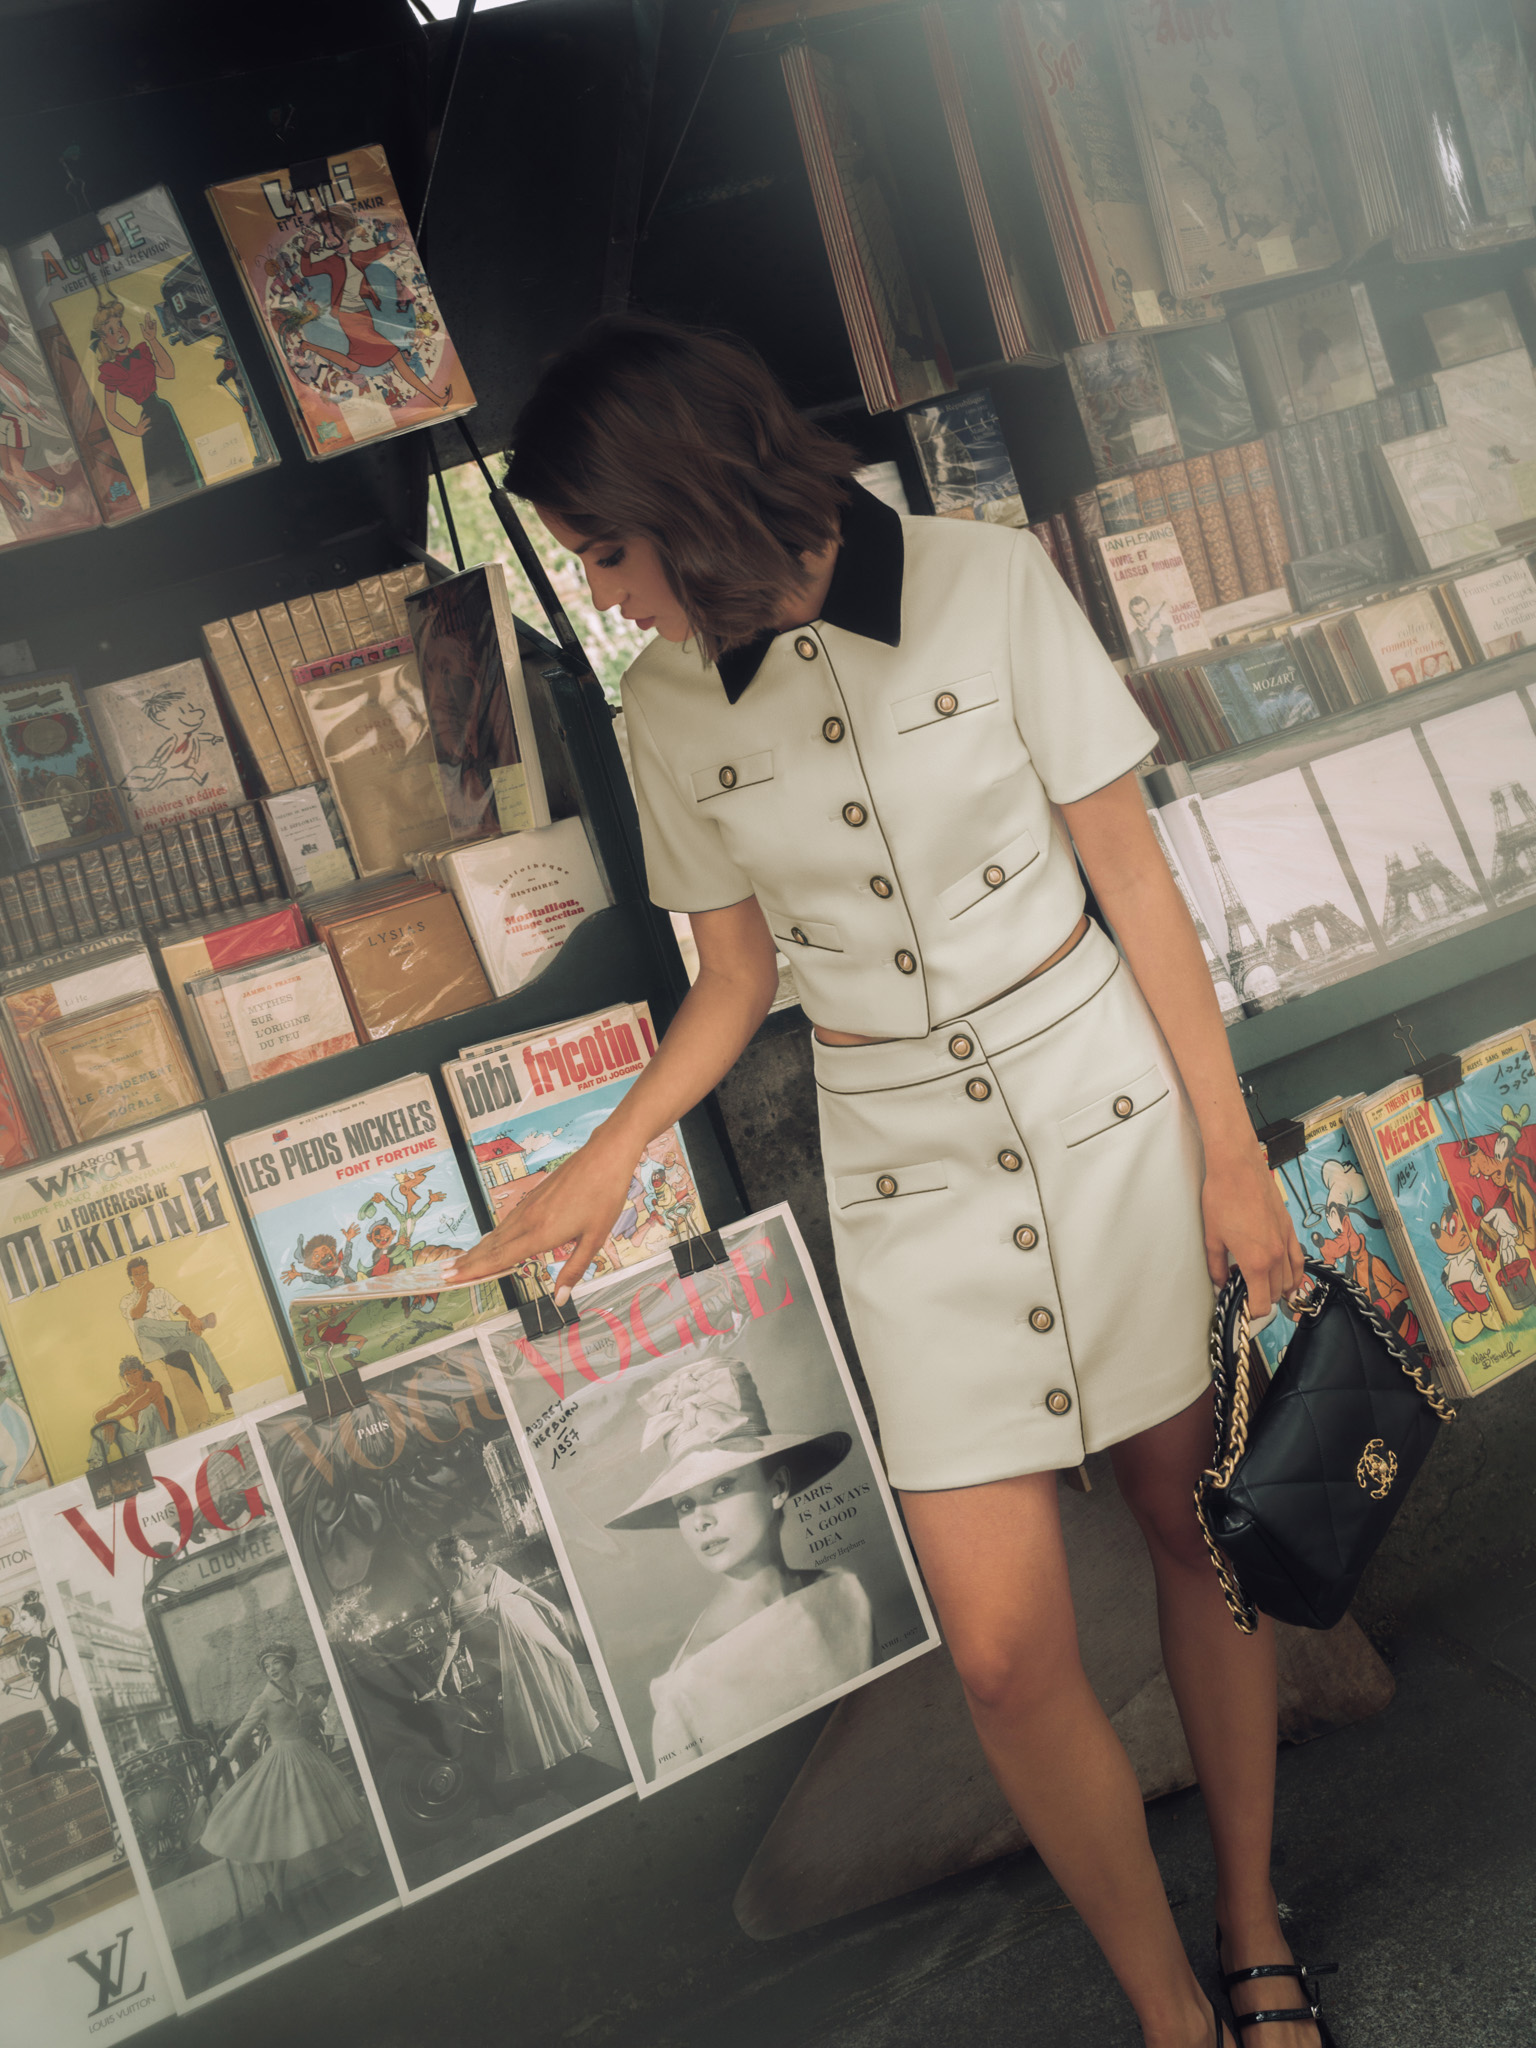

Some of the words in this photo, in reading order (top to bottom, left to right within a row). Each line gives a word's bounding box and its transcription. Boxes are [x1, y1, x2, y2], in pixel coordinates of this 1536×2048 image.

[351, 195, 386, 213] FAKIR
[1104, 540, 1124, 552] IAN
[1125, 527, 1174, 547] FLEMING
[1108, 553, 1134, 568] VIVRE
[1137, 549, 1148, 561] ET
[1113, 565, 1149, 582] LAISSER
[1151, 556, 1184, 573] MOURIR
[1170, 600, 1198, 614] JAMES
[1490, 595, 1506, 606] Les
[1172, 609, 1201, 625] BOND
[1381, 636, 1418, 655] romans
[1252, 671, 1295, 693] MOZART
[133, 801, 184, 821] Histoires
[185, 785, 228, 805] inédites
[188, 800, 229, 818] Nicolas
[510, 880, 560, 899] HISTOIRES
[504, 899, 580, 926] Montaillou,
[505, 919, 543, 936] village
[544, 906, 586, 924] occitan
[368, 921, 426, 947] LYSIAS
[243, 986, 266, 999] JAMES
[248, 993, 294, 1015] MYTHES
[251, 1013, 273, 1027] SUR
[255, 1014, 311, 1039] L'ORIGINE
[259, 1041, 276, 1051] DU
[279, 1031, 301, 1046] FEU
[455, 1053, 523, 1120] bibi
[522, 1018, 641, 1097] fricotin
[1485, 1053, 1500, 1064] SANS
[77, 1092, 95, 1106] LE
[98, 1063, 173, 1098] FONDEMENT
[577, 1081, 595, 1092] FAIT
[595, 1075, 608, 1086] DU
[608, 1062, 644, 1081] JOGGING
[108, 1092, 162, 1119] MORALE
[1384, 1090, 1410, 1114] THIERRY
[1411, 1086, 1423, 1098] LA
[1306, 1124, 1329, 1140] ENCONTRE
[1329, 1120, 1337, 1128] DU
[244, 1153, 281, 1194] LES
[280, 1132, 344, 1180] PIEDS
[342, 1099, 437, 1159] NICKELES
[336, 1160, 371, 1180] FONT
[375, 1137, 438, 1166] FORTUNE
[26, 1140, 152, 1203] WINCH
[69, 1151, 115, 1172] LARGO
[1396, 1161, 1418, 1198] 1964
[13, 1205, 51, 1224] PHILIPPE
[53, 1191, 92, 1211] FRANCQ
[102, 1182, 122, 1193] JEAN
[57, 1216, 71, 1233] LA
[71, 1182, 154, 1227] FORTERESSE
[154, 1182, 169, 1198] DE
[0, 1165, 230, 1305] MAKILING
[507, 1236, 794, 1401] VOGUE
[584, 1337, 616, 1357] PARIS
[278, 1350, 506, 1485] VOGU
[357, 1418, 391, 1440] PARIS
[525, 1399, 564, 1436] AUDREY
[533, 1401, 579, 1448] HEPBURN
[551, 1428, 580, 1470] 1957
[793, 1482, 833, 1508] PARIS
[798, 1509, 813, 1523] IS
[818, 1482, 871, 1515] ALWAYS
[54, 1444, 267, 1578] VOG
[142, 1507, 177, 1529] PARIS
[805, 1527, 814, 1539] A
[818, 1506, 857, 1531] GOOD
[809, 1531, 843, 1554] IDEA
[814, 1552, 837, 1568] Audrey
[837, 1538, 867, 1557] Hepburn
[197, 1538, 275, 1579] LOUVRE
[658, 1750, 677, 1764] PRIX
[89, 2013, 116, 2034] LOUIS
[116, 1994, 157, 2019] VUITTON
